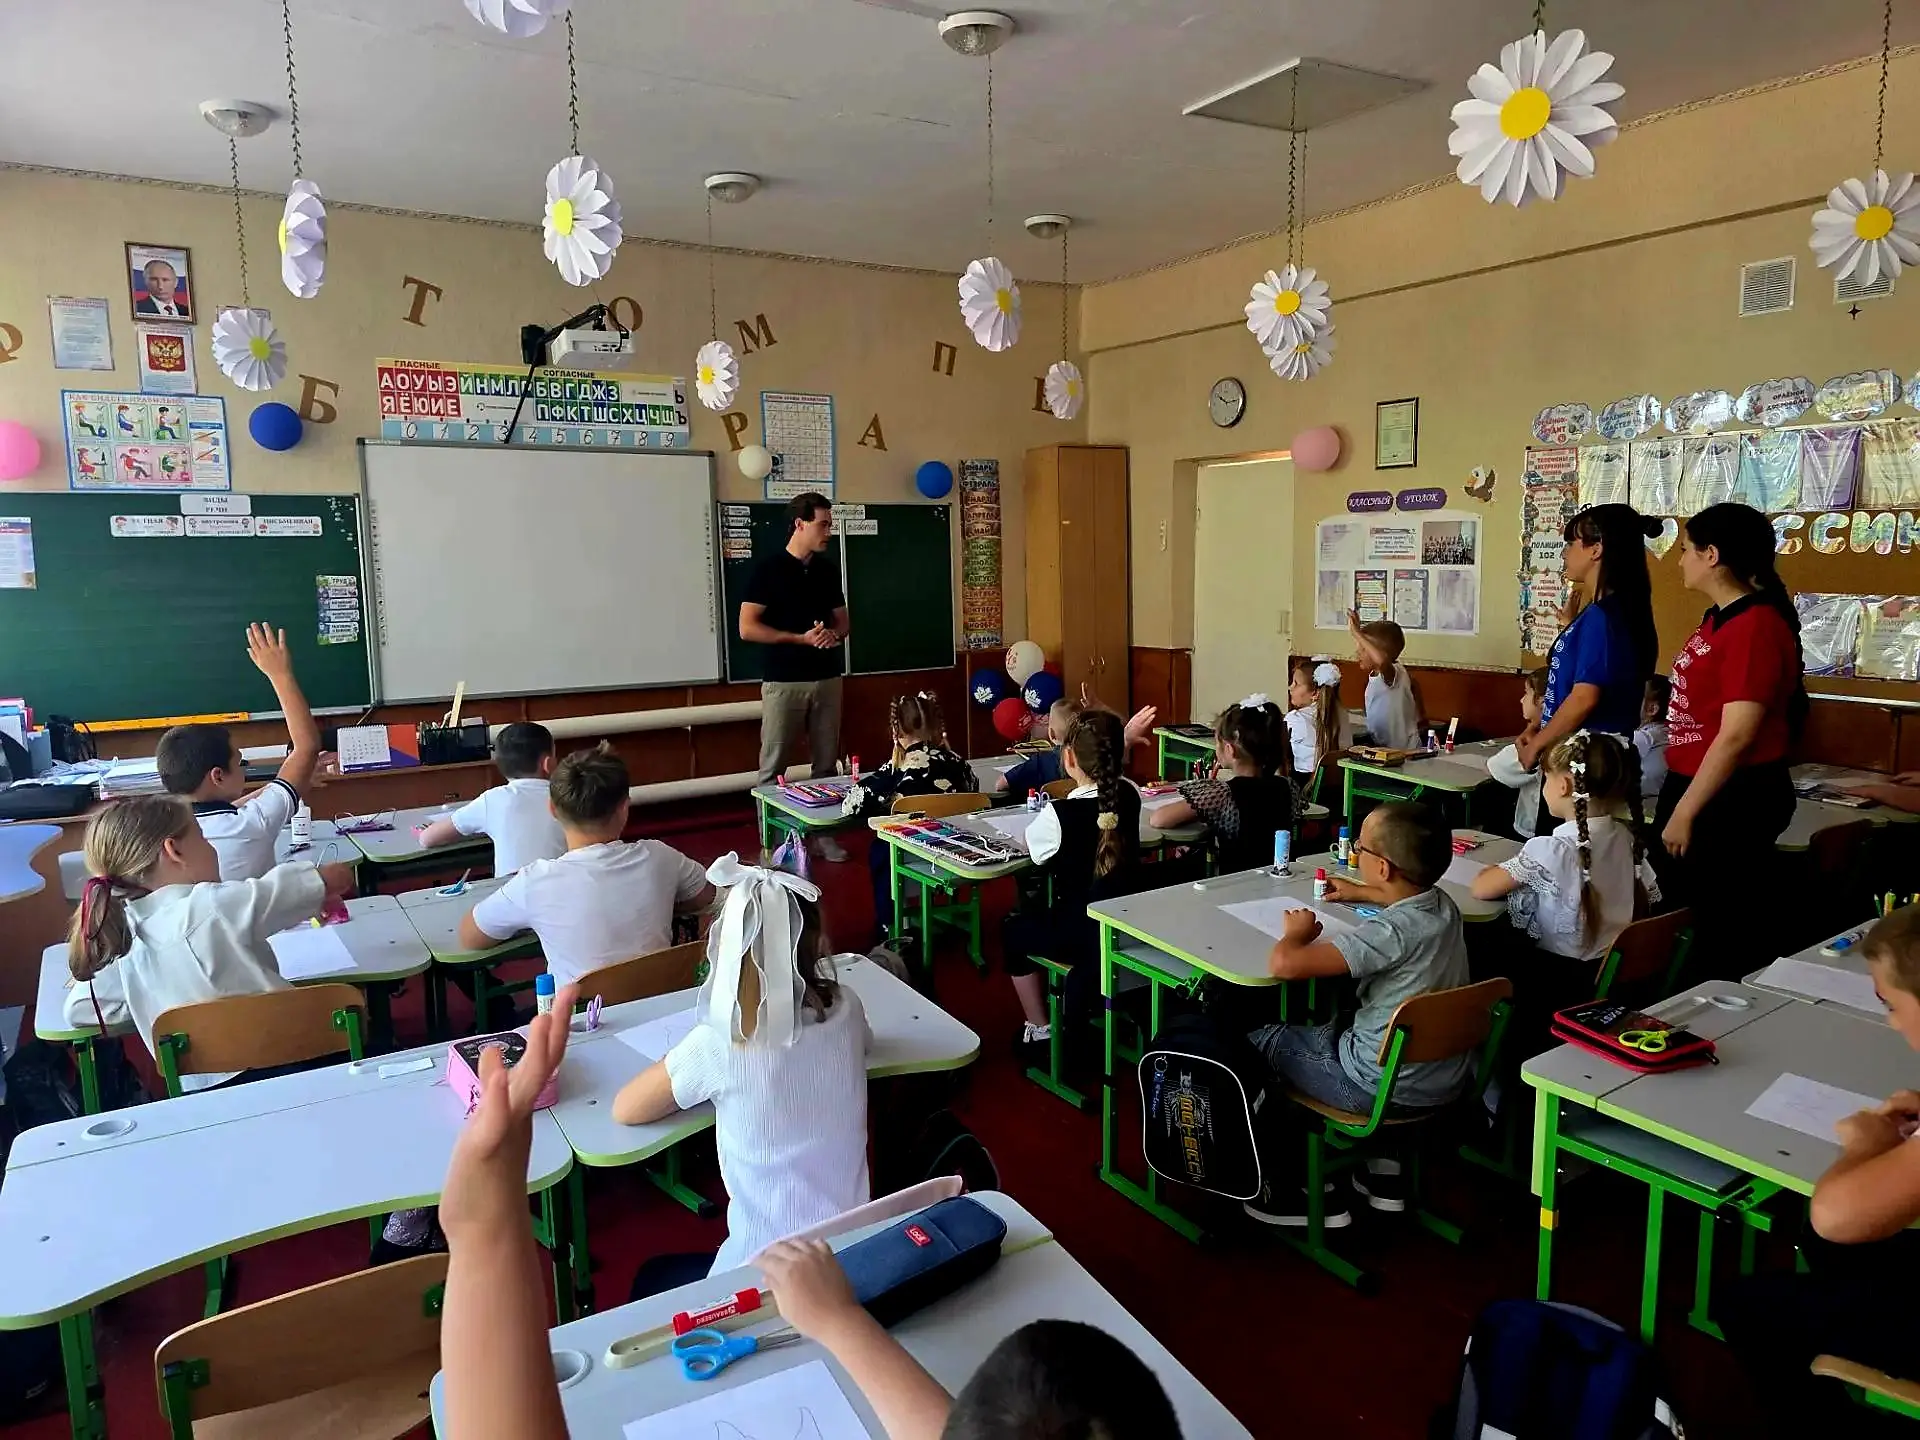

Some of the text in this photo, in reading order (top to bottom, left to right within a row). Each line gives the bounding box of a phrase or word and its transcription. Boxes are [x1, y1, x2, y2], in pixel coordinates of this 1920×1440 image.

[394, 360, 441, 370] ГЛАСНЫЕ
[543, 369, 596, 379] СОГЛАСНЫЕ
[1404, 493, 1440, 504] УГОЛОК
